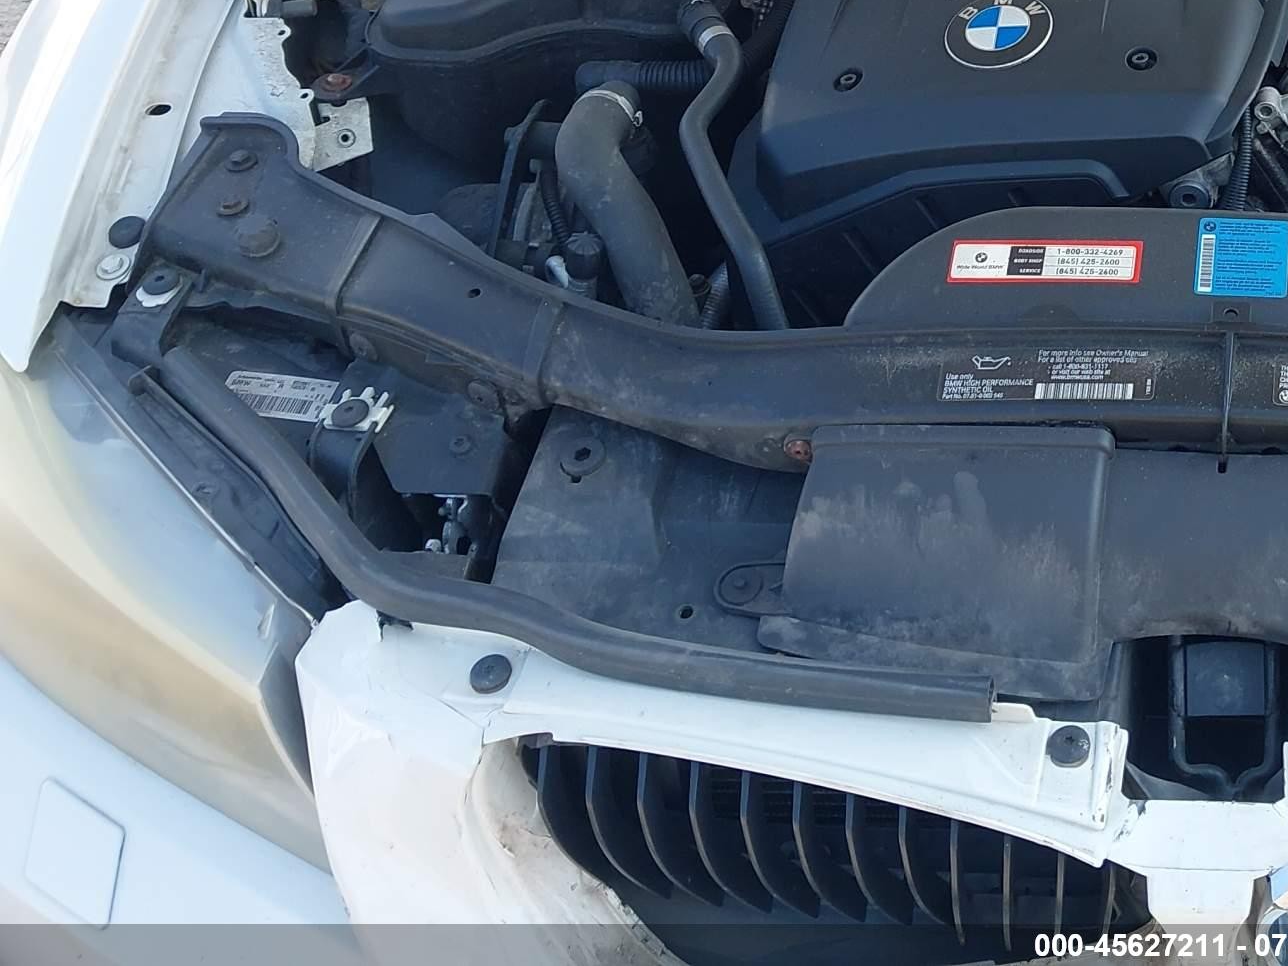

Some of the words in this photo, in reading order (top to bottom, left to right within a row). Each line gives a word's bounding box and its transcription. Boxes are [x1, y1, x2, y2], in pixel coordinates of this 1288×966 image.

[1057, 248, 1123, 256] 1-800-332-4269
[1057, 257, 1079, 266] (845)
[1081, 257, 1120, 266] 425-2600
[1056, 267, 1078, 275] (845)
[1079, 267, 1119, 276] 425-2600
[1096, 349, 1123, 357] Owner's
[959, 373, 974, 381] only
[963, 379, 980, 387] HIGH
[981, 378, 1034, 386] PERFORMANCE
[943, 386, 981, 394] SYNTHETIC
